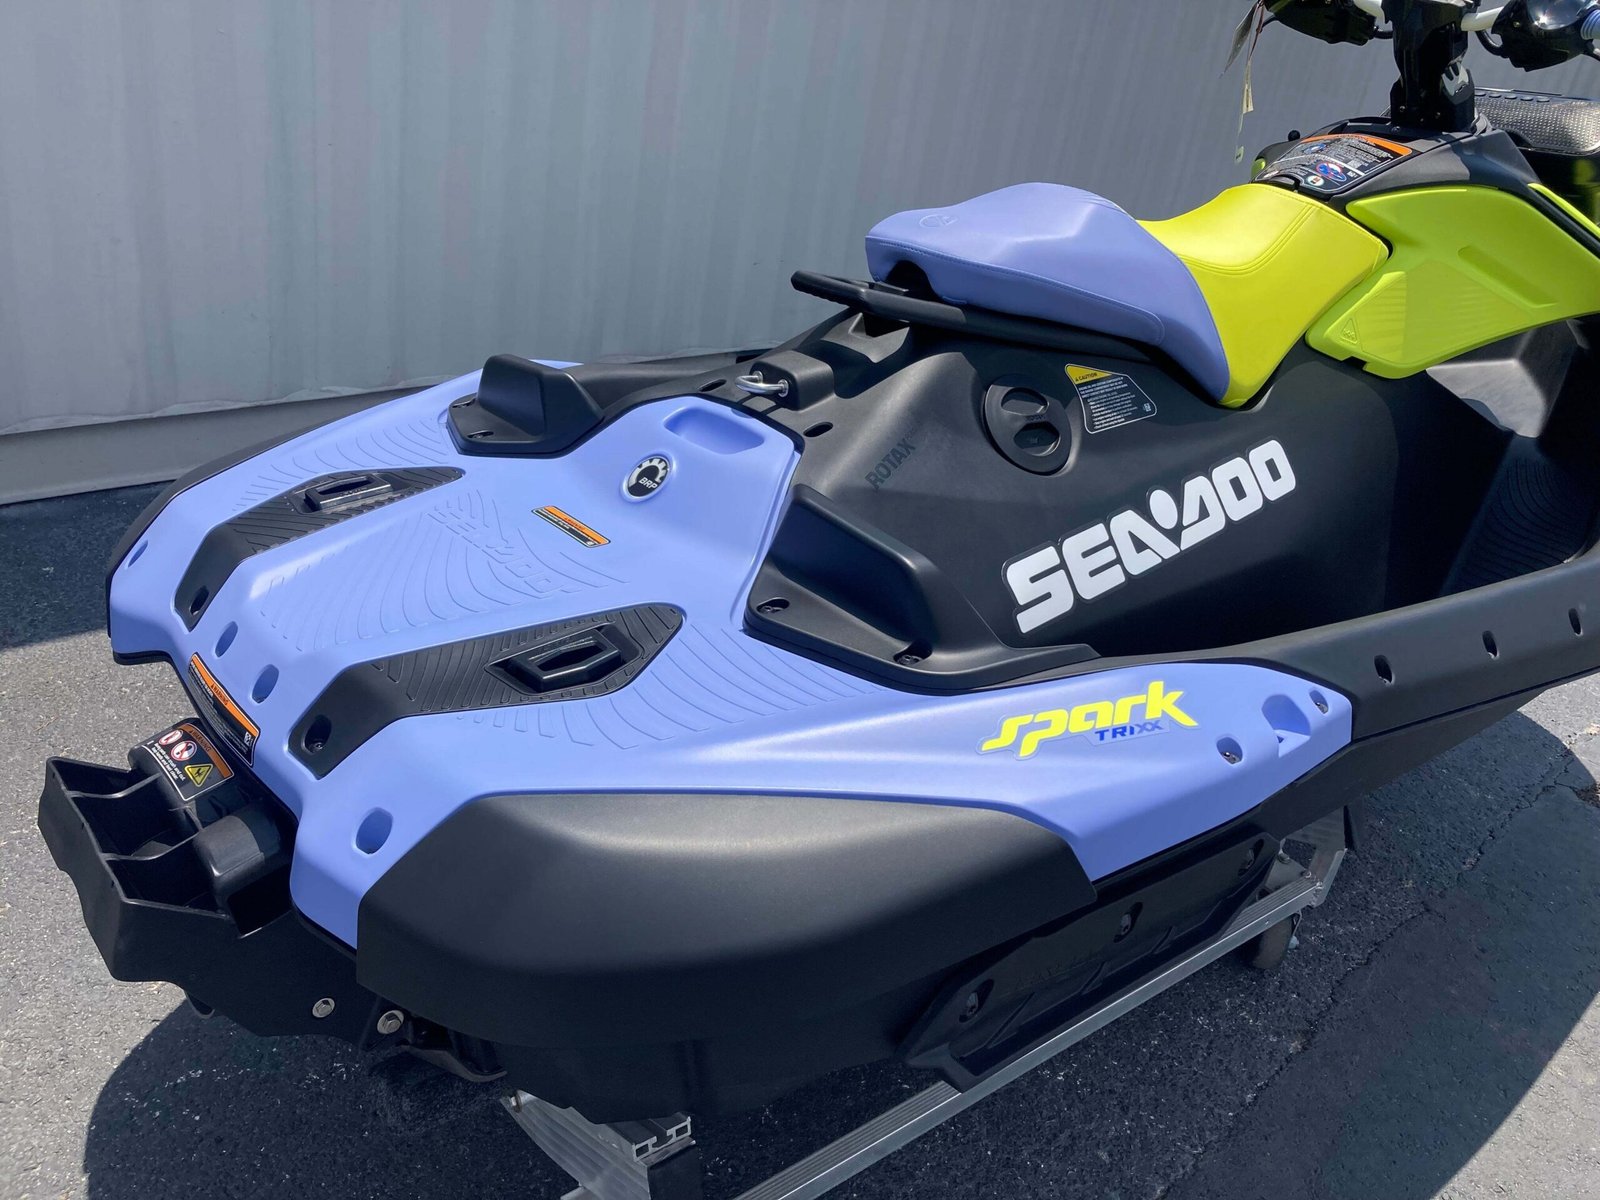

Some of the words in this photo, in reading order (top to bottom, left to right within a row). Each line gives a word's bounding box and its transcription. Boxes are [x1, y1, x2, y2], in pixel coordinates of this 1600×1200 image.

[1079, 373, 1098, 381] CAUTION
[638, 477, 658, 490] BRP
[1095, 720, 1163, 741] TRIXX
[191, 729, 212, 752] WARNING
